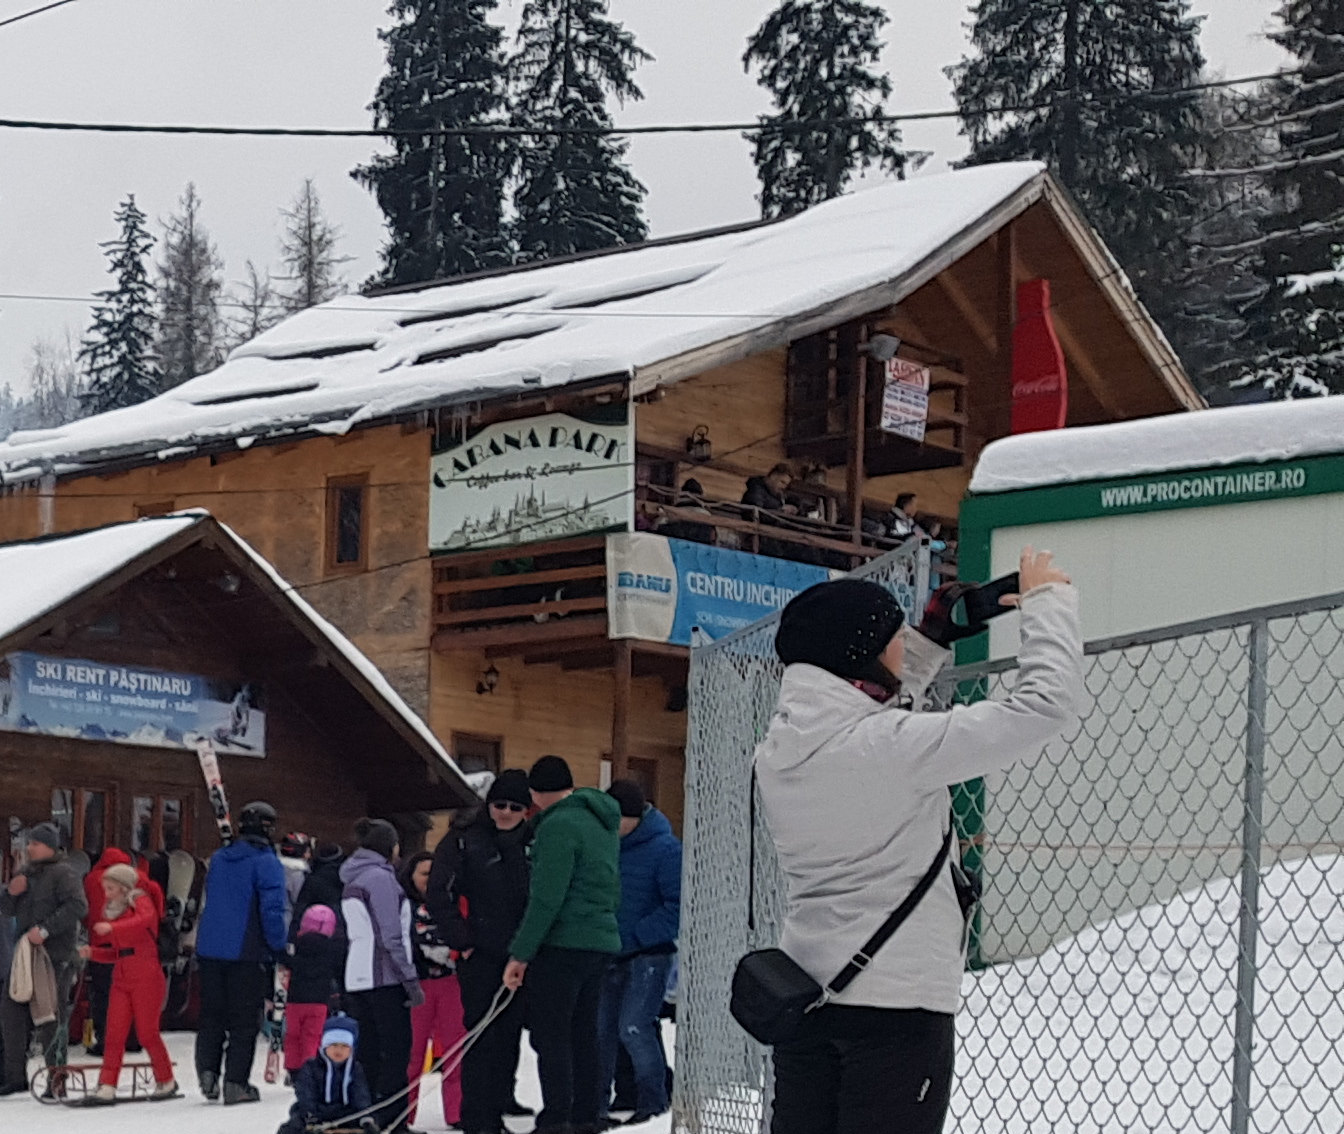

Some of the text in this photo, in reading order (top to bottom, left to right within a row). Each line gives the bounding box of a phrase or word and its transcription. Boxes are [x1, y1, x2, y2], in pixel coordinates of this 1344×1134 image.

[433, 426, 627, 488] CABANA PARK
[1100, 468, 1305, 508] WWW.PROCONTAINER.RO
[686, 571, 744, 600] CENTRU
[36, 661, 62, 680] SKI
[66, 664, 106, 686] RENT
[86, 689, 102, 702] ski
[111, 693, 167, 710] snowboard
